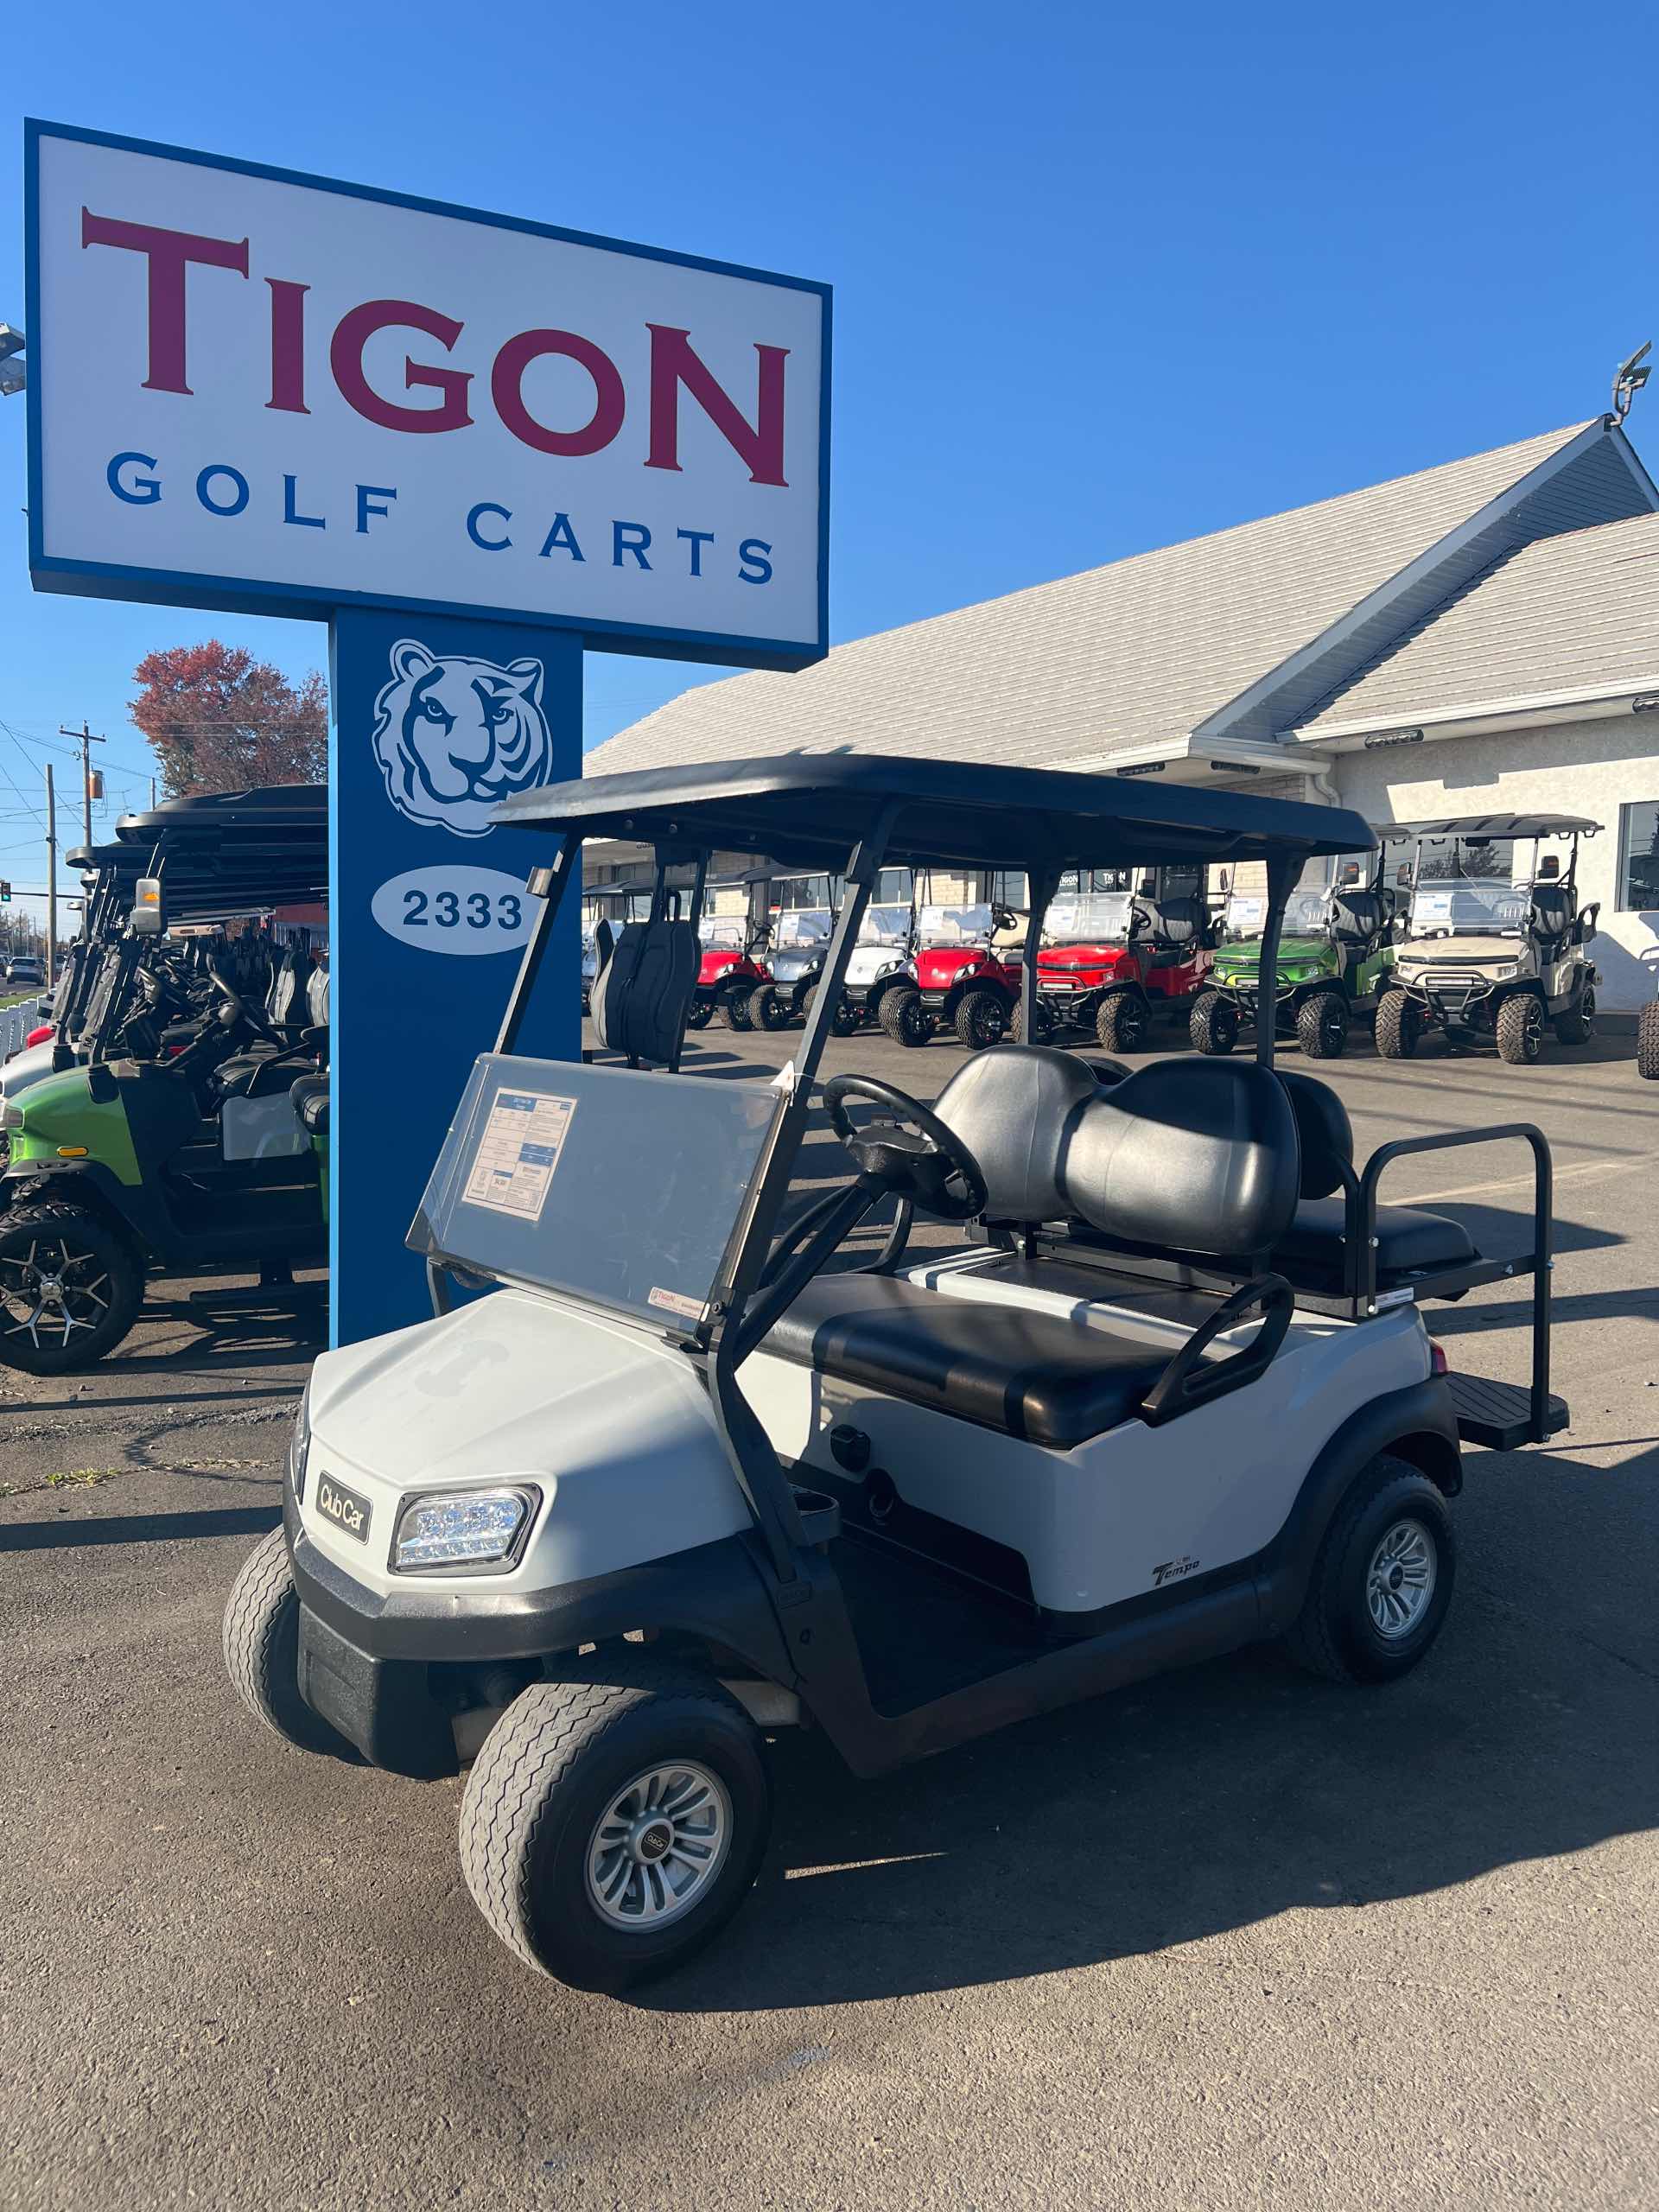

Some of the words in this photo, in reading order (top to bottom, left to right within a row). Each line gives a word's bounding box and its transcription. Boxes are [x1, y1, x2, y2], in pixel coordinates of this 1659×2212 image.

[80, 204, 791, 487] TIGON
[106, 451, 397, 534] GOLF
[467, 502, 773, 585] CARTS
[1103, 871, 1126, 880] TIGN
[403, 889, 522, 930] 2333
[1152, 1560, 1200, 1586] Tempo
